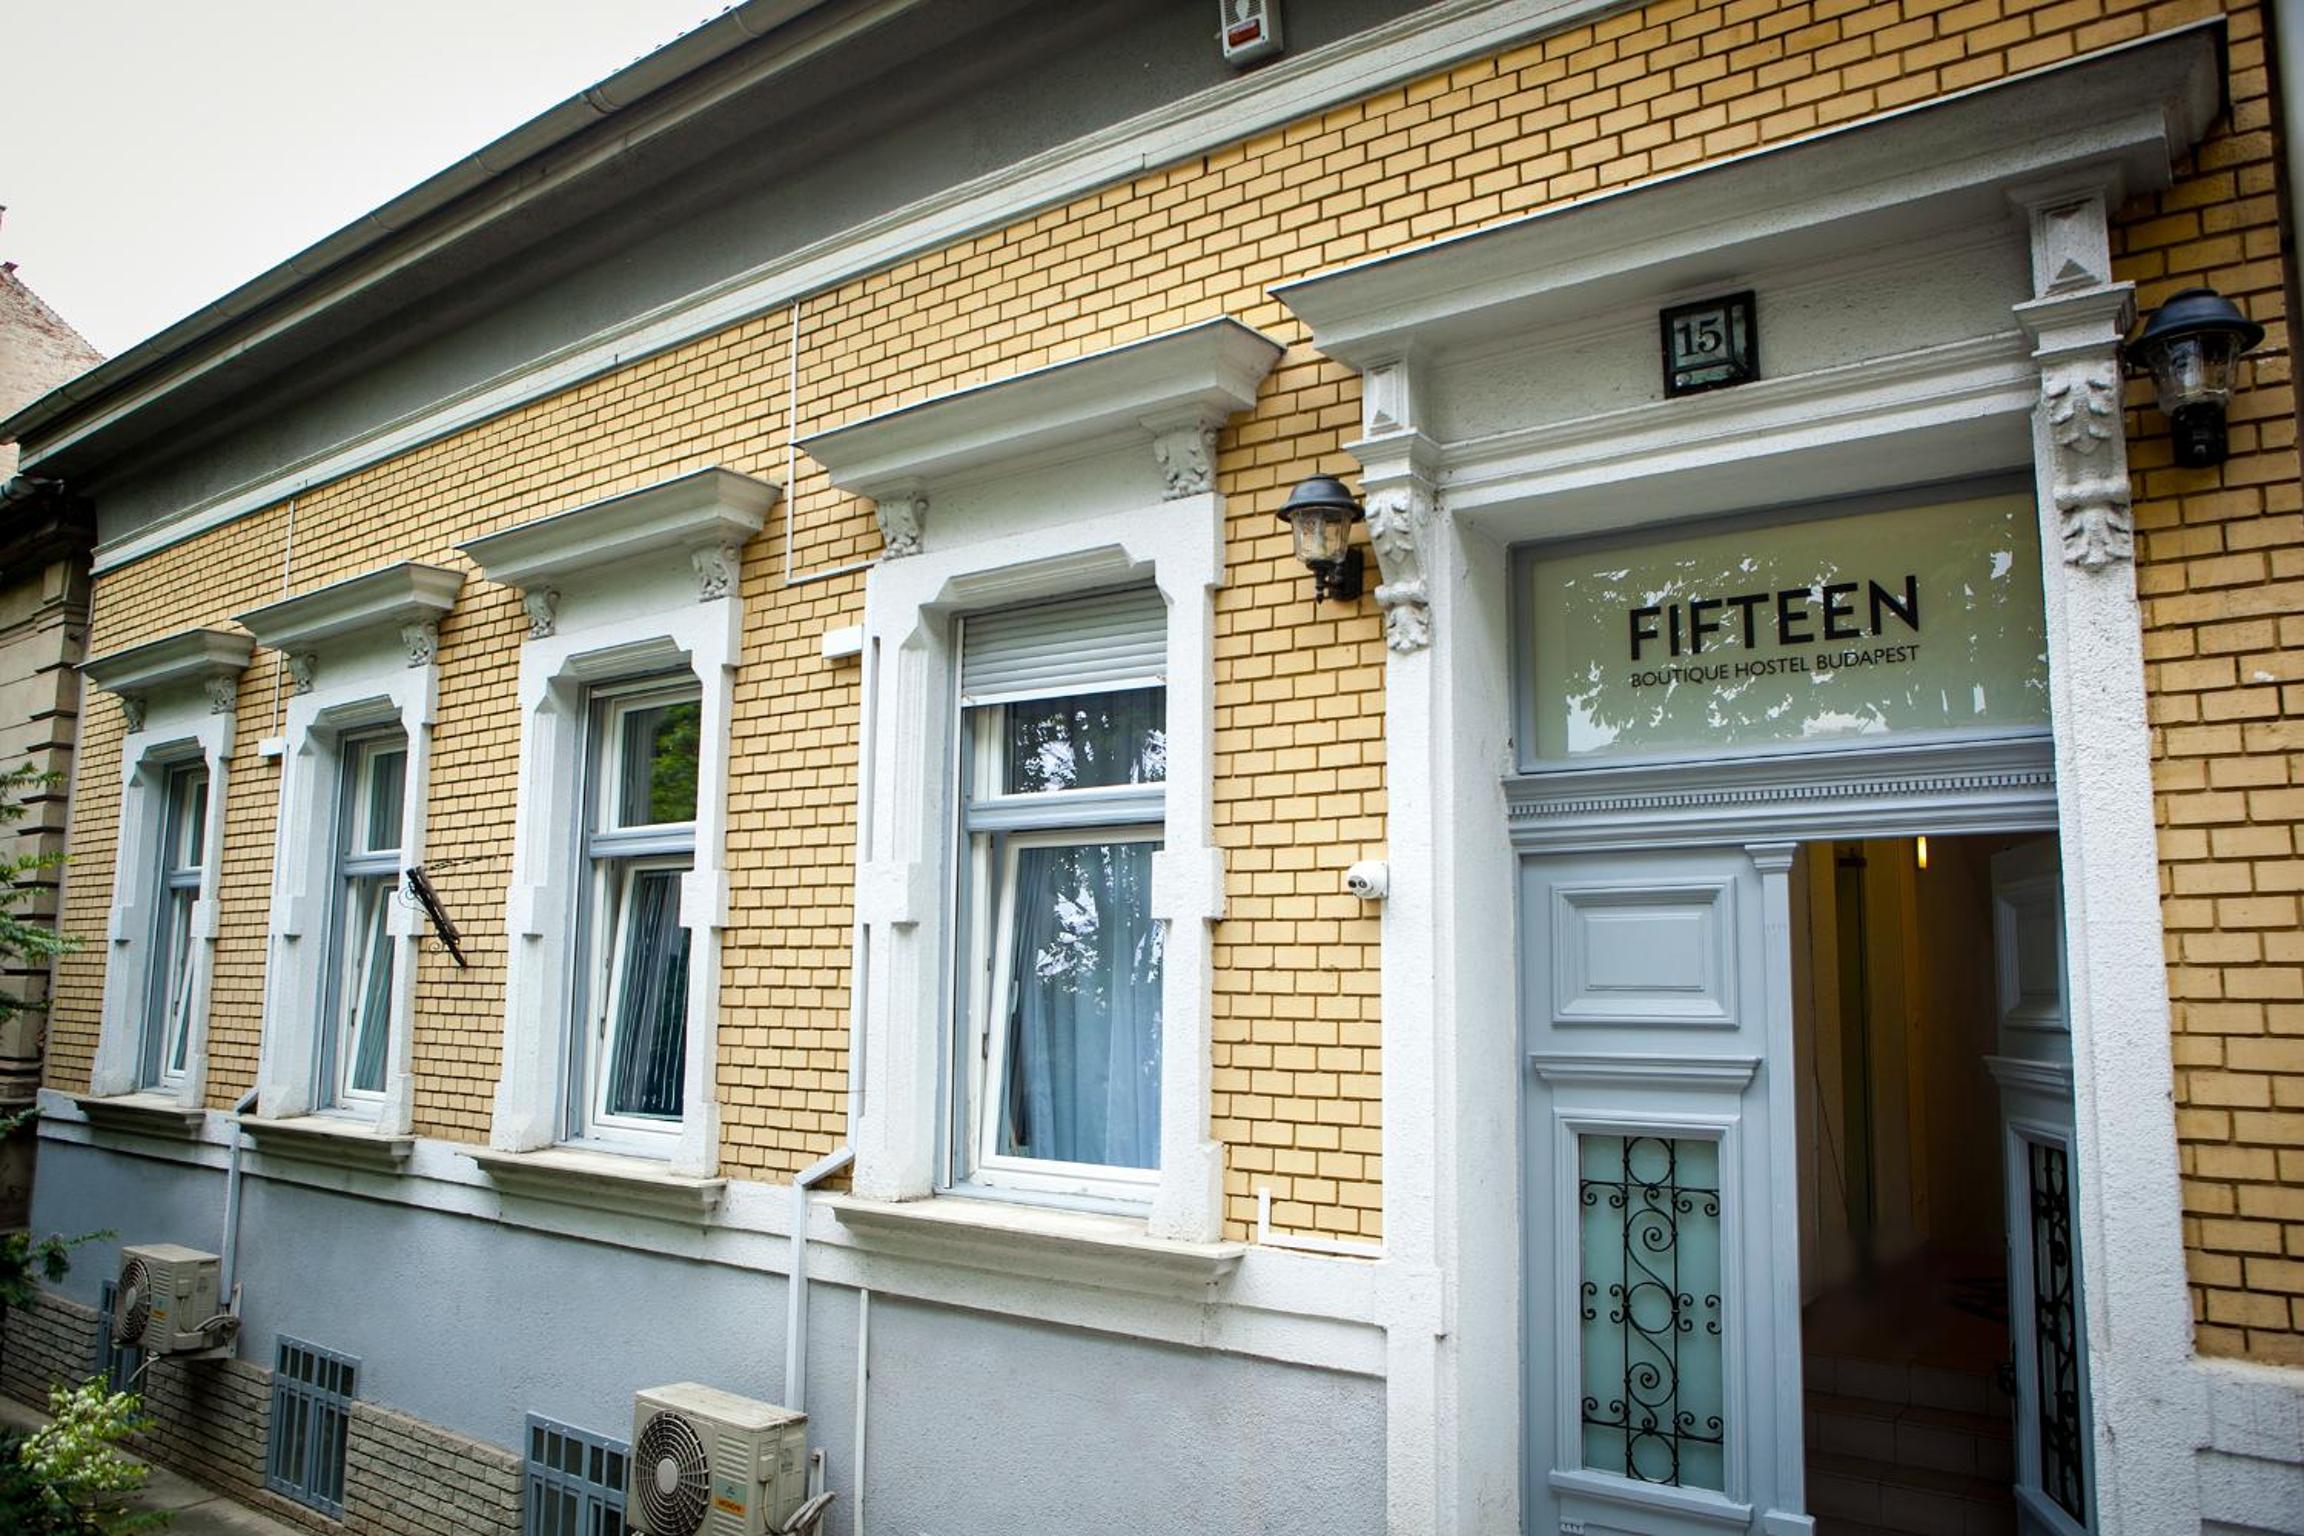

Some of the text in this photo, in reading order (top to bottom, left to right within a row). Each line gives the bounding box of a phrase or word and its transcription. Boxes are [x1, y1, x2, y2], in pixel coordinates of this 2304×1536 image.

[1676, 317, 1722, 357] 15
[1629, 575, 1919, 661] FIFTEEN
[1631, 645, 1920, 688] BOUTIQUE HOSTEL BUDAPEST
